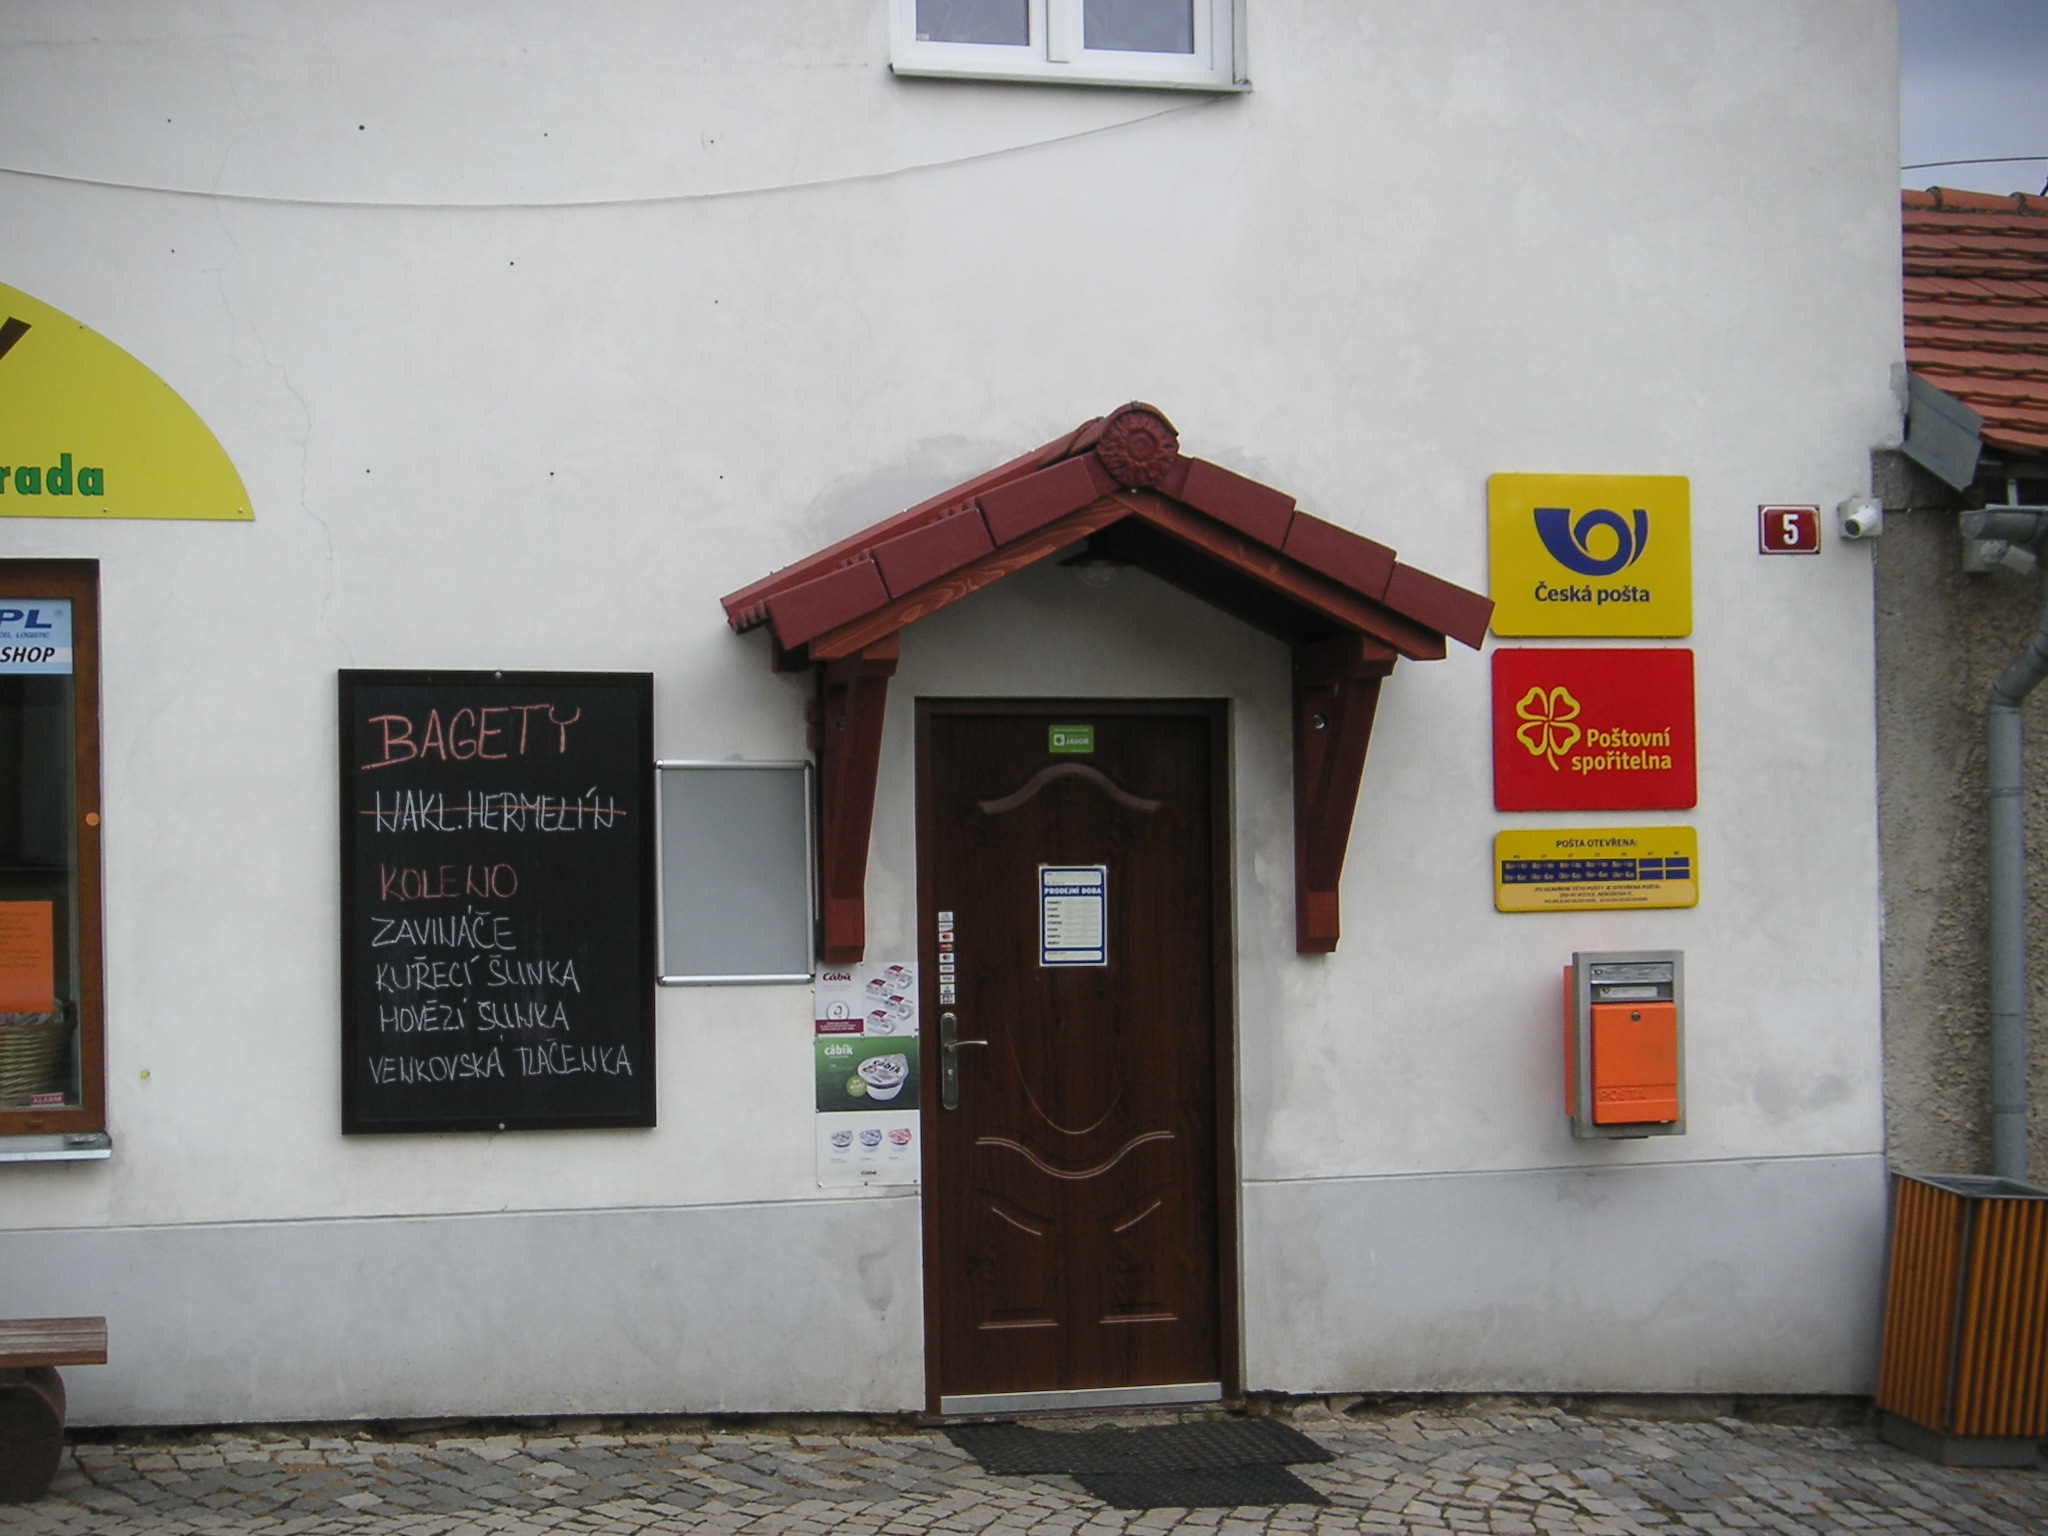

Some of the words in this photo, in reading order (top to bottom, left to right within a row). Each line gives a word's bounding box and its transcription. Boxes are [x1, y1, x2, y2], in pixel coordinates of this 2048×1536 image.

[0, 453, 104, 496] rada
[1783, 513, 1799, 545] 5
[1534, 581, 1592, 602] Česká
[1598, 585, 1650, 605] pošta
[0, 646, 56, 663] SHOP
[361, 704, 580, 770] BAGETY
[1586, 727, 1671, 747] Poštovní
[1572, 750, 1672, 776] spořitelna
[1556, 838, 1585, 848] POŠTA
[381, 863, 518, 901] KOLENO
[1081, 887, 1102, 895] DOBA
[376, 955, 480, 993] KUŘECÍ
[488, 955, 580, 993] ŠUNKA
[379, 998, 467, 1032] HOVĚZÍ
[368, 1035, 505, 1084] VENKOVSKÁ
